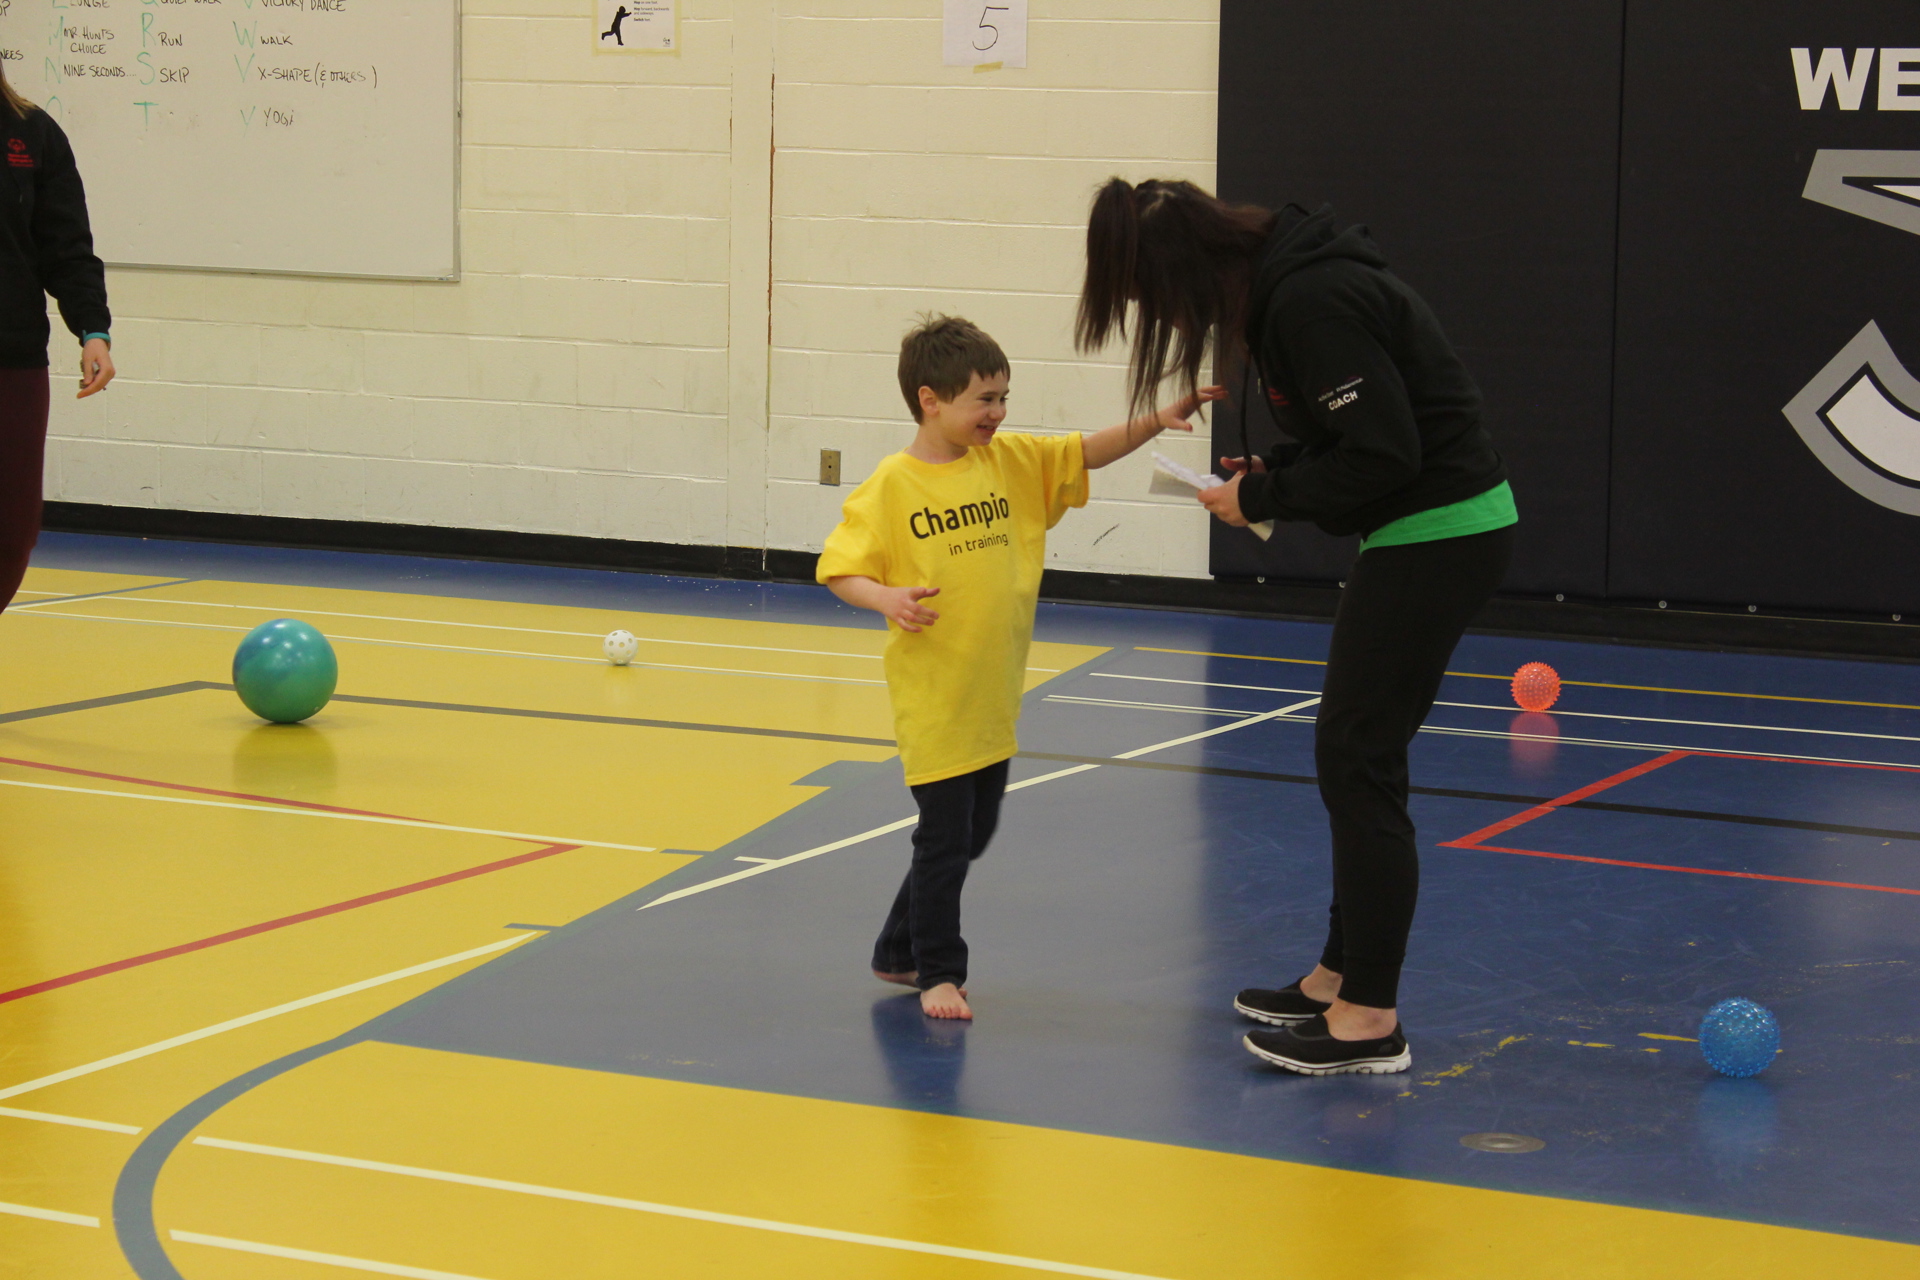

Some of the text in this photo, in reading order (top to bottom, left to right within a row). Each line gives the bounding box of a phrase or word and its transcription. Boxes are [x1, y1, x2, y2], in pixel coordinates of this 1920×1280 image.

[141, 12, 183, 48] R RUN
[232, 20, 293, 49] W WALK
[971, 6, 1010, 52] 5
[70, 42, 107, 54] CHOICE
[63, 64, 86, 77] NINE
[136, 51, 190, 85] S SKIP
[1328, 390, 1359, 411] COACH
[948, 533, 1009, 556] in training
